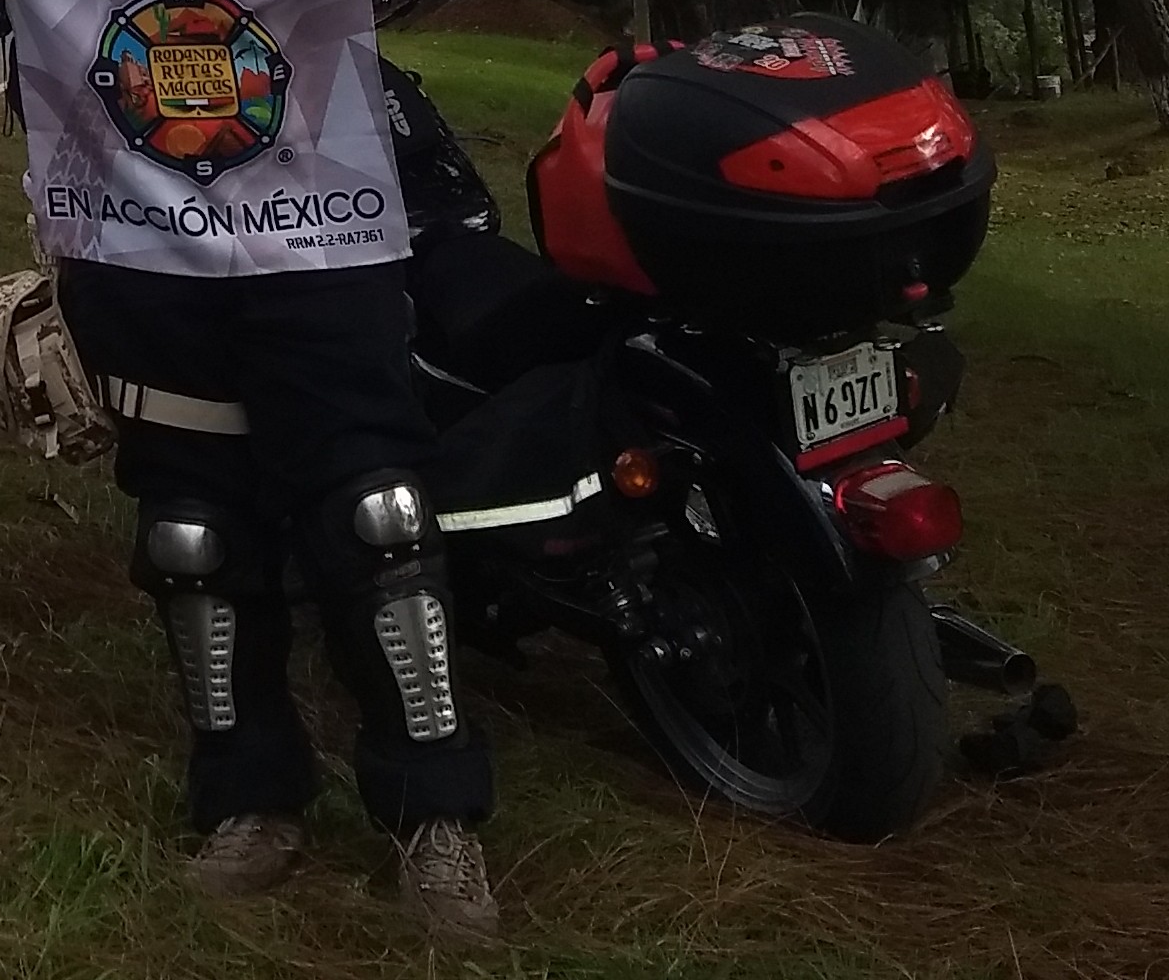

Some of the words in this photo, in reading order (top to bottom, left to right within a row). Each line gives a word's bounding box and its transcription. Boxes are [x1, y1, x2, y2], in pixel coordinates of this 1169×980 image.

[95, 71, 115, 87] O
[273, 65, 285, 81] E
[196, 161, 213, 176] S
[47, 187, 93, 220] EN
[101, 194, 236, 238] ACCIÓN
[242, 187, 385, 234] MÉXICO
